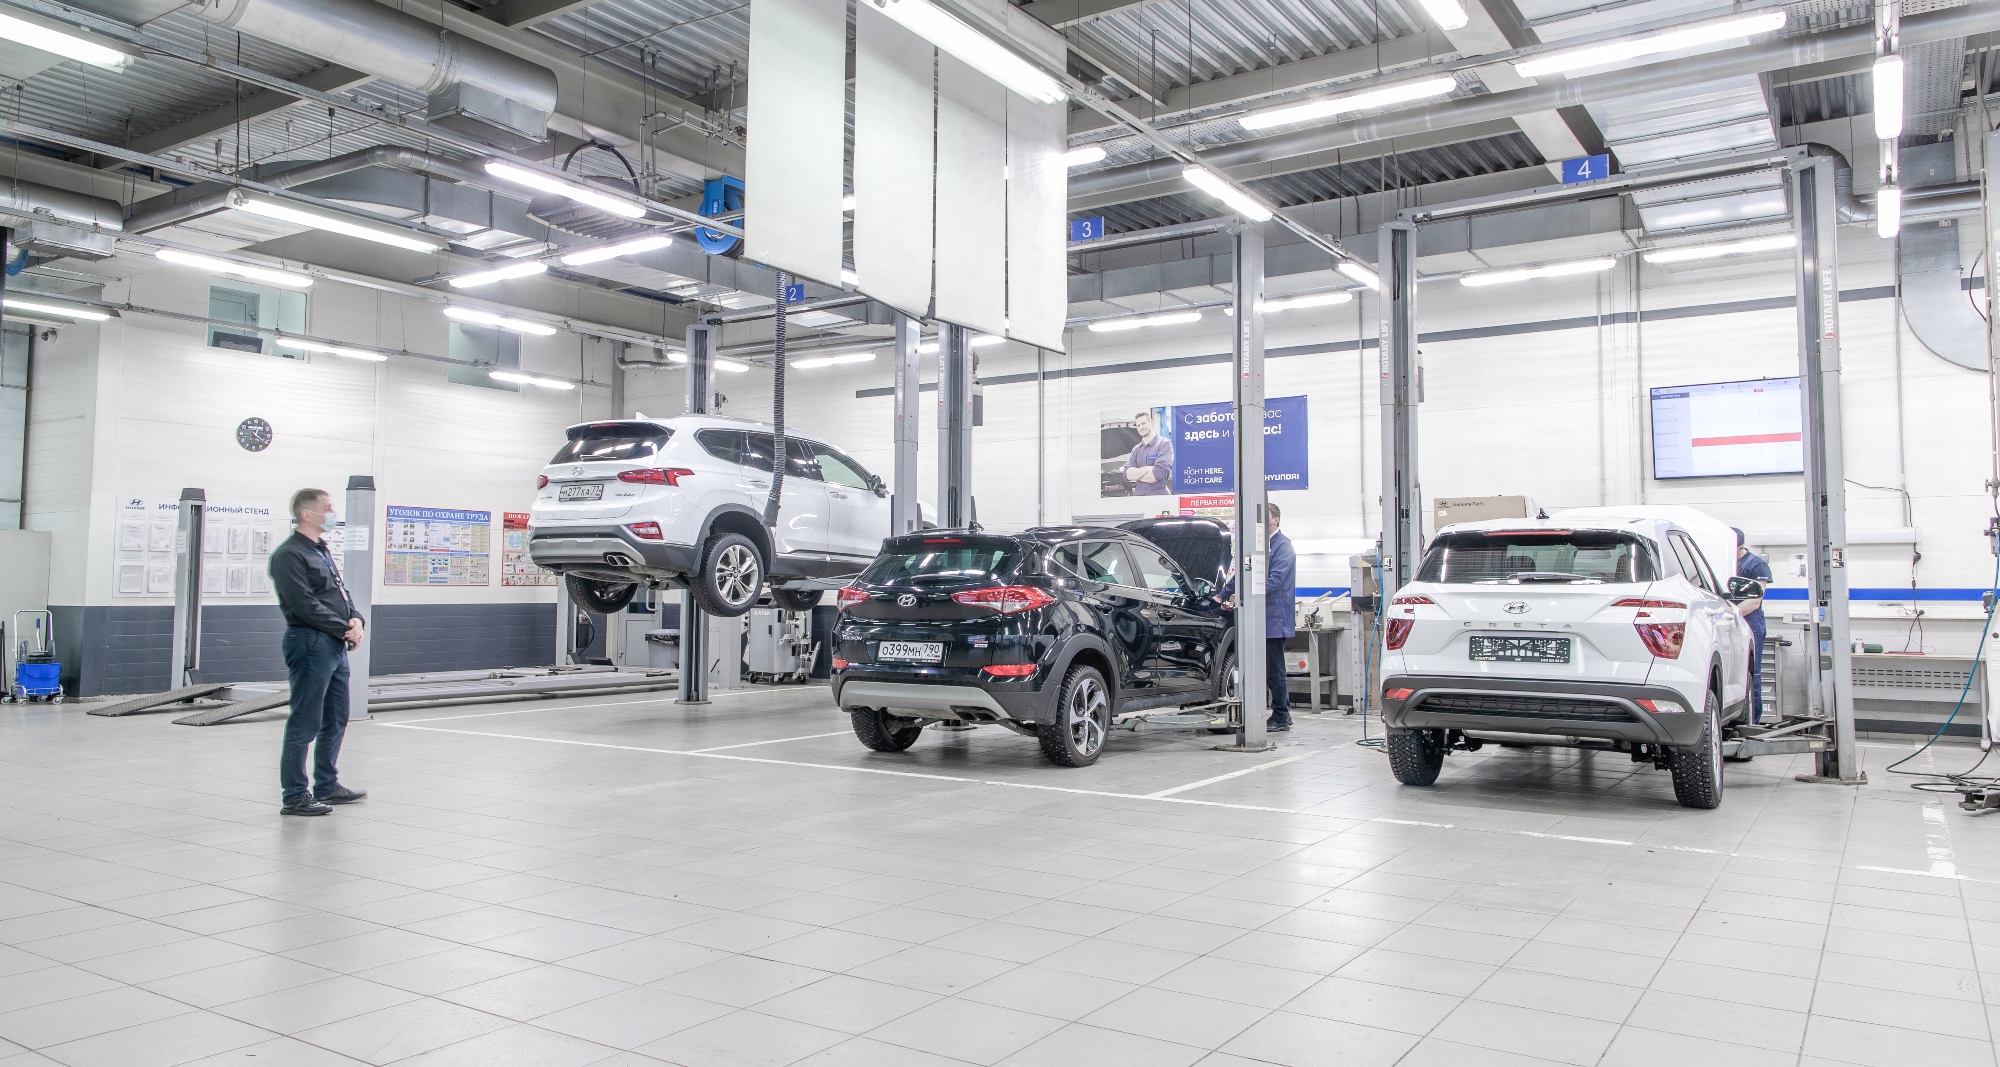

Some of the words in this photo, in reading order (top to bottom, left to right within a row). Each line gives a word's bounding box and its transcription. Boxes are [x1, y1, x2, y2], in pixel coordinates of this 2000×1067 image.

[1577, 159, 1592, 179] 4
[1082, 221, 1092, 238] 3
[1822, 269, 1832, 291] LIFT
[789, 287, 797, 301] 2
[1823, 293, 1834, 333] ROTARY
[1381, 319, 1389, 337] LIFT
[1381, 340, 1389, 372] ROTARY
[1184, 413, 1194, 425] С
[1184, 429, 1220, 441] здесь
[1222, 429, 1230, 438] и
[1204, 467, 1224, 475] HERE,
[1264, 473, 1300, 481] HYUNDAI
[1204, 476, 1223, 484] CARE
[1190, 499, 1218, 507] ПЕРВАЯ
[243, 507, 269, 516] СТЕНД
[389, 507, 420, 517] УГОЛОК
[422, 509, 434, 518] ПО
[435, 510, 465, 520] ОХРАНЕ
[465, 512, 489, 521] ТРУДА
[1463, 621, 1573, 629] CRETA
[841, 633, 863, 641] TUCSON
